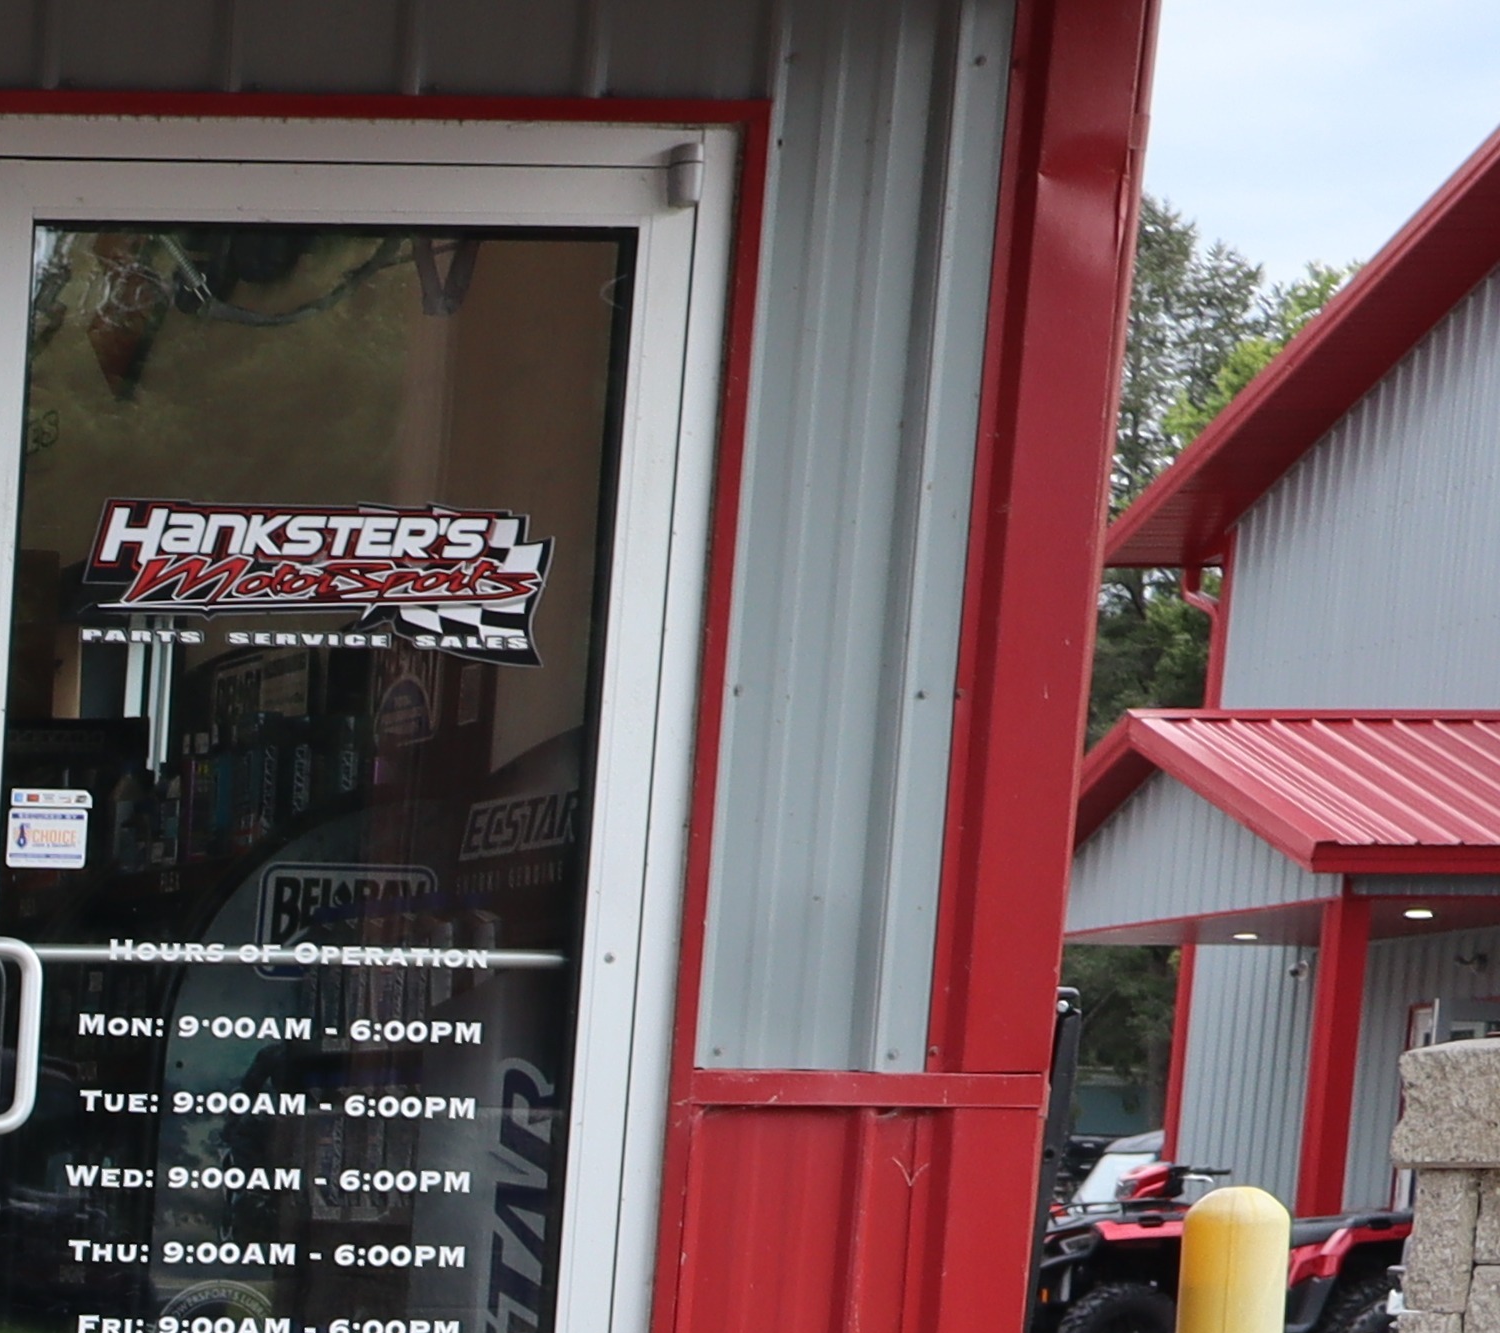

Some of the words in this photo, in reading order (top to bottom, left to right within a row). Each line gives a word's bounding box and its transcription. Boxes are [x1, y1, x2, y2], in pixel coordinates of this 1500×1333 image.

[81, 629, 202, 644] PARTS
[229, 632, 390, 647] SERVICE
[416, 635, 530, 650] SALES
[32, 830, 76, 843] CHOICE
[109, 938, 224, 963] HOURS
[239, 943, 282, 964] OF
[294, 942, 488, 969] OPERATION
[79, 1014, 163, 1036] MON:
[351, 1020, 481, 1044] 6:00PM
[80, 1090, 158, 1112] TUE:
[174, 1092, 305, 1115] 9:00AM
[345, 1096, 475, 1119] 6:00PM
[66, 1165, 153, 1187] WED:
[169, 1167, 300, 1190] 9:00AM
[340, 1170, 470, 1193] 6:00PM
[69, 1240, 148, 1262] THU:
[164, 1242, 295, 1264] 9:00AM
[335, 1245, 464, 1267] 6:00PM
